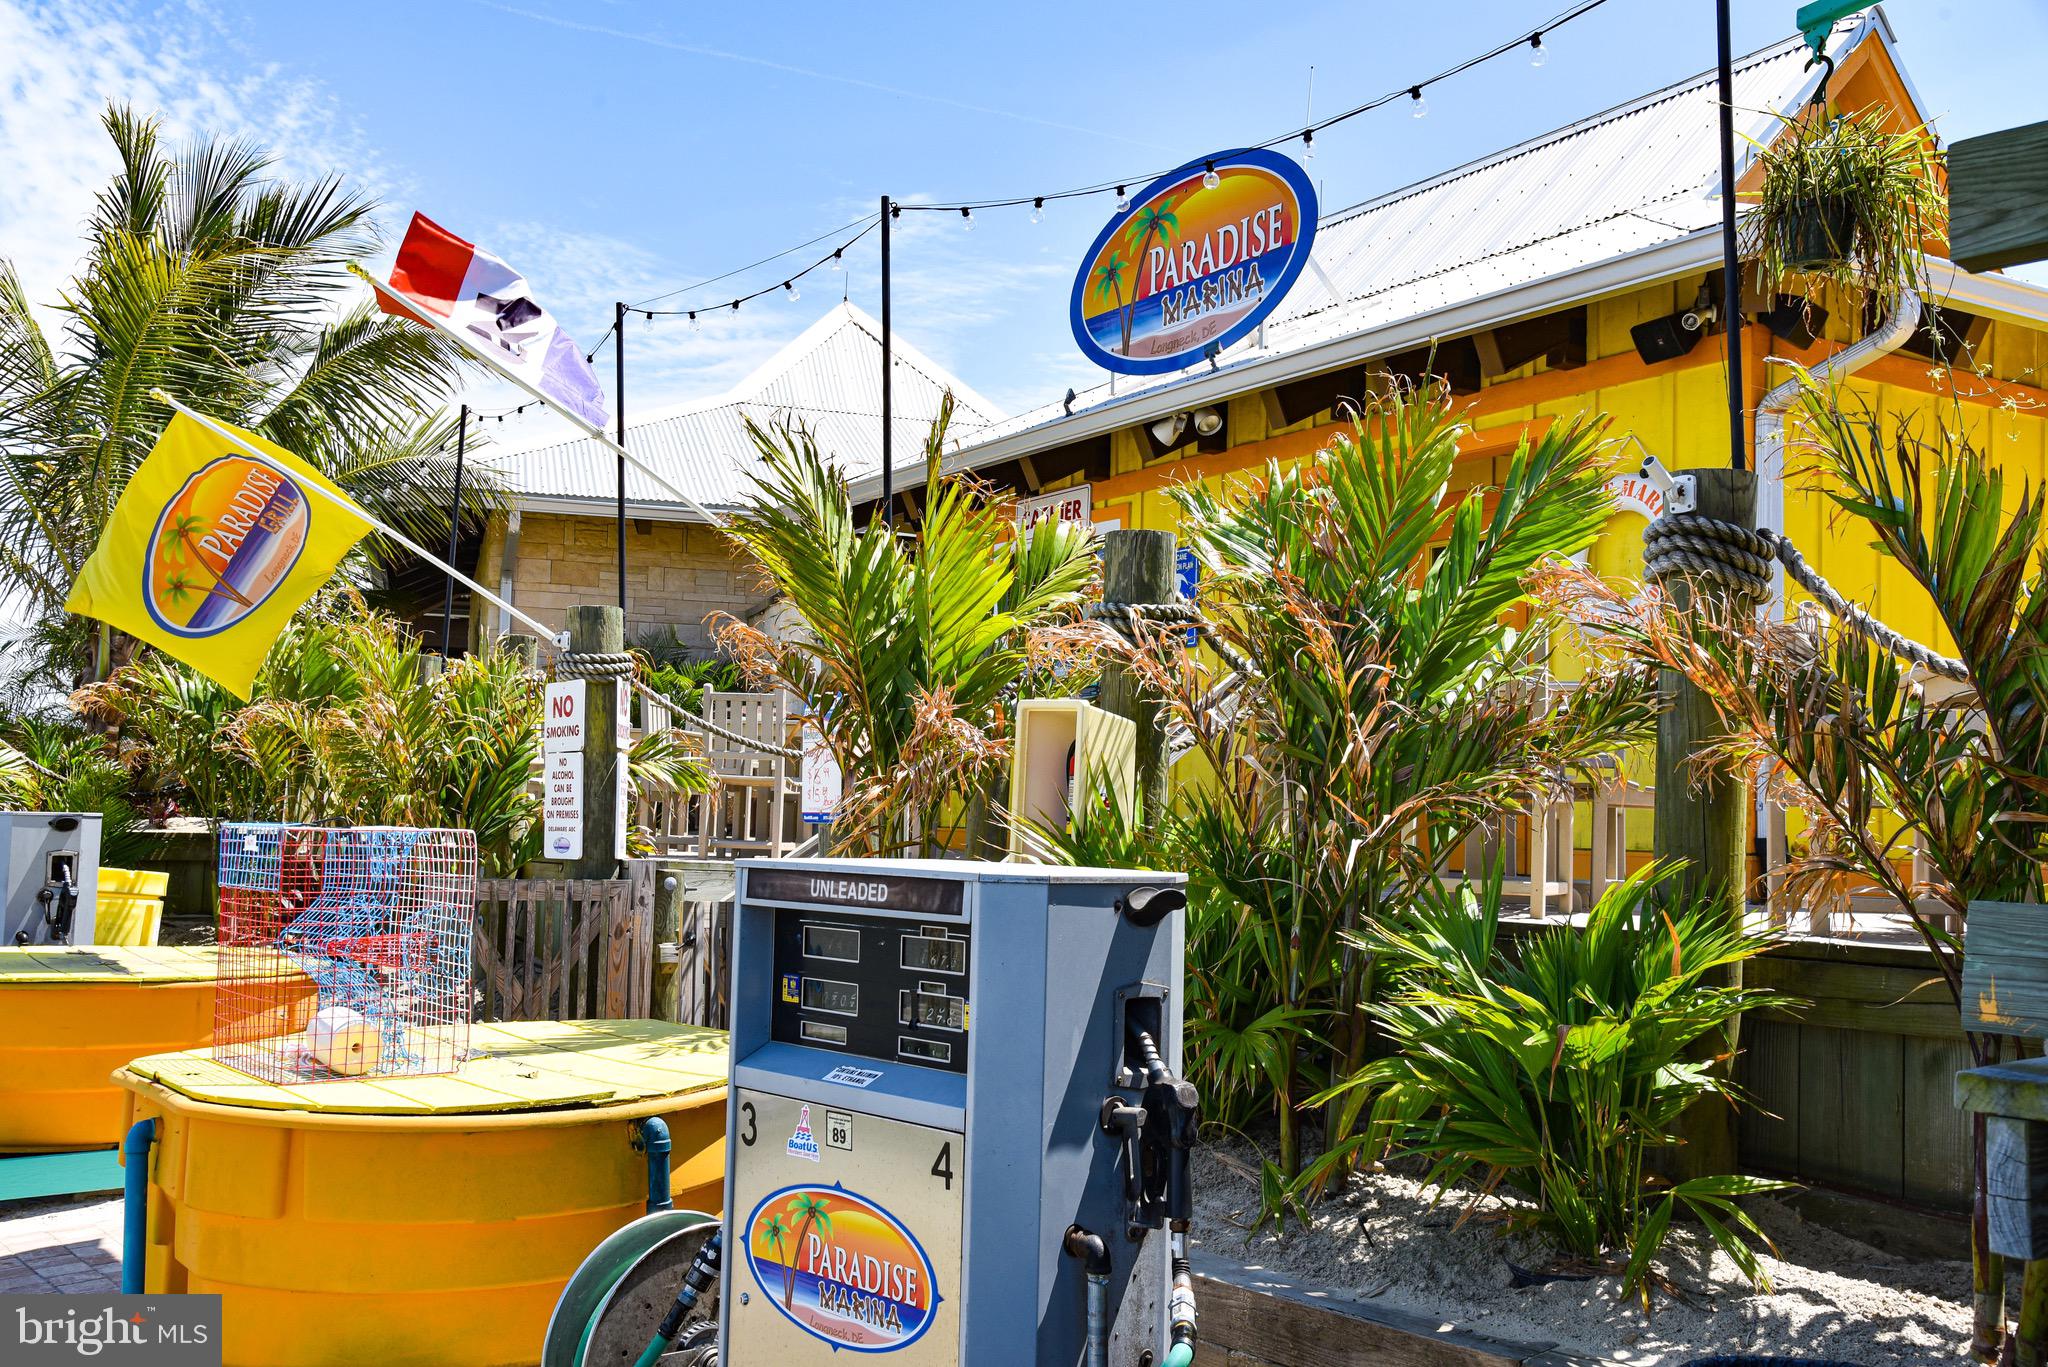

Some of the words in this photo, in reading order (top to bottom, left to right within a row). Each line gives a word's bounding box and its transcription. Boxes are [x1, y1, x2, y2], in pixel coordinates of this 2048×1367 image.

[1148, 203, 1283, 297] PARADISE
[1161, 263, 1264, 327] MARINA
[1150, 330, 1200, 354] Longneck,
[1202, 320, 1217, 339] DE
[198, 467, 281, 564] PARADISE
[258, 493, 300, 535] GRILL
[552, 694, 574, 718] NO
[546, 724, 580, 739] SMOKING
[558, 758, 568, 767] NO
[552, 771, 575, 780] ALCOHOL
[553, 784, 565, 793] CAN
[566, 784, 573, 793] BE
[551, 797, 575, 806] BROUGHT
[546, 810, 555, 819] ON
[556, 810, 579, 819] PREMISES
[810, 879, 888, 902] UNLEADED
[741, 1102, 757, 1147] 3
[832, 1127, 847, 1144] 89
[931, 1141, 953, 1190] 4
[807, 1233, 918, 1307] PARADISE
[818, 1281, 903, 1334] MARINA
[852, 1331, 864, 1344] DE
